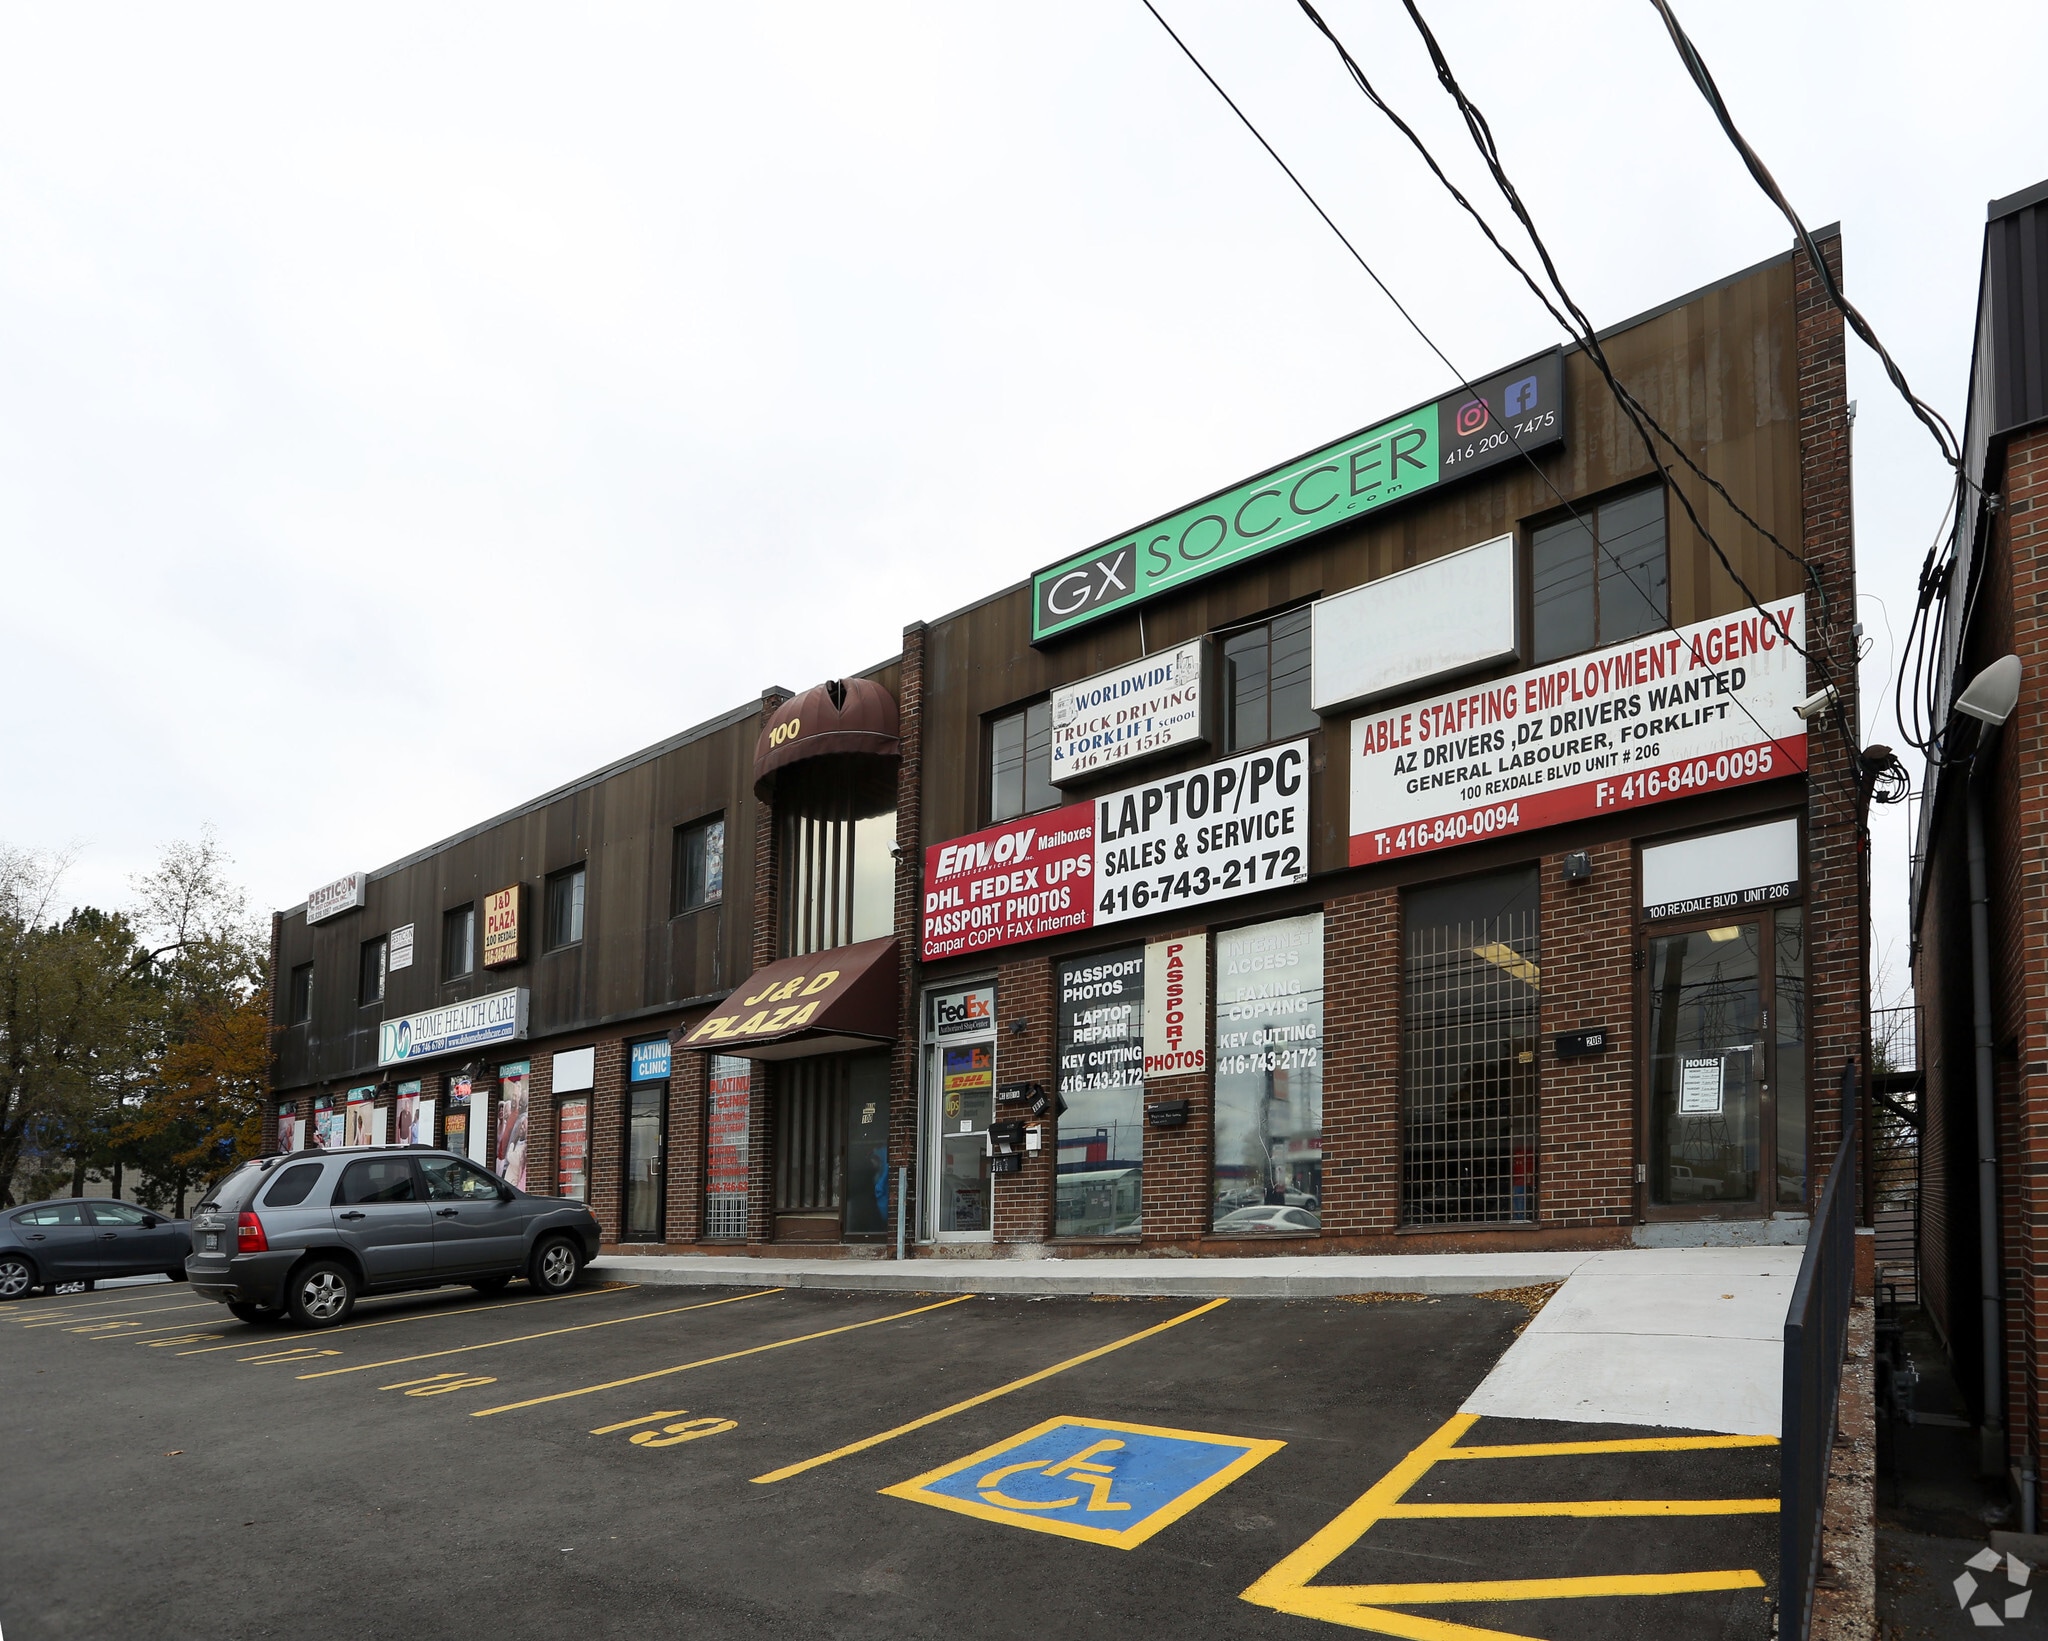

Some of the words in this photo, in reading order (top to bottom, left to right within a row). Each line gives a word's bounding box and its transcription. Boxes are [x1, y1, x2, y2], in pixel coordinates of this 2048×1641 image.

[1445, 444, 1474, 465] 416
[1479, 430, 1509, 454] 200
[1514, 411, 1555, 439] 7475
[1047, 550, 1127, 616] GX
[1145, 428, 1427, 578] SOCCER
[1076, 663, 1174, 711] WORLDWIDE
[1362, 713, 1412, 757] ABLE
[1418, 684, 1517, 742] STAFFING
[1525, 638, 1681, 714] EMPLOYMENT
[1688, 606, 1795, 671] AGENCY
[1054, 714, 1111, 744] TRUCK
[1116, 686, 1196, 725] DRIVING
[1393, 751, 1418, 776] AZ
[1423, 729, 1505, 768] DRIVERS
[1550, 694, 1641, 737] DRIVERS
[1648, 667, 1746, 712] WANTED
[769, 718, 801, 748] 100
[1054, 746, 1065, 761] &
[1069, 717, 1155, 757] FORKLIFT
[1158, 710, 1196, 729] SCHOOL
[1406, 761, 1492, 794] GENERAL
[1498, 732, 1613, 773] LABOURER,
[1620, 701, 1730, 744] FORKLIFT
[1071, 752, 1098, 771] 416
[1103, 742, 1129, 761] 741
[1136, 728, 1172, 750] 1515
[1460, 784, 1482, 801] 100
[1485, 770, 1543, 796] REXDALE
[1547, 760, 1581, 782] BLVD
[1585, 752, 1619, 772] UNIT
[1622, 748, 1631, 764] #
[1635, 743, 1660, 761] 206
[1595, 782, 1615, 808] F:
[1620, 746, 1773, 801] 416-840-0095
[1101, 749, 1301, 843] LAPTOP/PC
[1105, 838, 1166, 877] SALES
[1174, 833, 1189, 860] &
[1197, 806, 1295, 854] SERVICE
[1374, 832, 1391, 856] T:
[1395, 802, 1520, 851] 416-840-0094
[936, 828, 1036, 879] Envoy
[1038, 826, 1092, 851] Mailboxes
[925, 886, 964, 914] DHL
[970, 867, 1039, 902] FEDEX
[1045, 854, 1092, 885] UPS
[934, 869, 971, 885] BUSINESS
[972, 860, 1012, 875] SERVICES
[1099, 846, 1301, 915] 416-743-2172
[308, 875, 356, 908] PESTICON
[1650, 905, 1666, 919] 100
[1667, 897, 1712, 916] REXDALE
[1713, 892, 1738, 908] BLVD
[1743, 887, 1767, 903] UNIT
[1769, 884, 1789, 899] 206
[488, 909, 516, 934] PLAZA
[925, 901, 1002, 938] PASSPORT
[1006, 886, 1071, 921] PHOTOS
[486, 934, 497, 947] 100
[498, 928, 517, 944] REXDALE
[924, 936, 966, 955] Canpar
[968, 925, 1005, 947] COPY
[1007, 919, 1033, 939] FAX
[1036, 909, 1086, 933] Internet
[1227, 927, 1313, 957] INTERNET
[1063, 959, 1143, 986] PASSPORT
[1227, 951, 1300, 975] ACCESS
[1063, 980, 1123, 1003] PHOTOS
[1165, 943, 1184, 1051] PASSPORT
[1236, 977, 1300, 1002] FAXING
[415, 1013, 443, 1041] HOME
[444, 1002, 485, 1034] HEALTH
[488, 995, 516, 1023] CARE
[686, 1000, 821, 1043] PLAZA
[937, 994, 990, 1023] FedEx
[1073, 1004, 1132, 1026] LAPTOP
[1229, 997, 1308, 1021] COPYING
[940, 1023, 964, 1034] Authorized
[1073, 1022, 1127, 1043] REPAIR
[1220, 1031, 1248, 1049] KEY
[1252, 1024, 1317, 1047] CUTTING
[1586, 1035, 1602, 1047] 206
[411, 1045, 421, 1055] 416
[421, 1041, 431, 1053] 746
[431, 1038, 445, 1050] 6789
[947, 1048, 991, 1073] FedEx
[1062, 1053, 1086, 1069] KEY
[1088, 1046, 1143, 1066] CUTTING
[1144, 1049, 1204, 1073] PHOTOS
[1219, 1047, 1317, 1075] 416-743-2172
[499, 1063, 522, 1077] Diapers
[639, 1060, 667, 1076] CLINIC
[1685, 1058, 1719, 1068] HOURS
[951, 1074, 986, 1089] DHL
[1060, 1067, 1143, 1093] 416-743-2172
[717, 1094, 749, 1109] CLINIC
[947, 1101, 959, 1115] ups
[236, 1347, 344, 1365] 17
[378, 1372, 498, 1397] 18
[589, 1409, 739, 1448] 19
